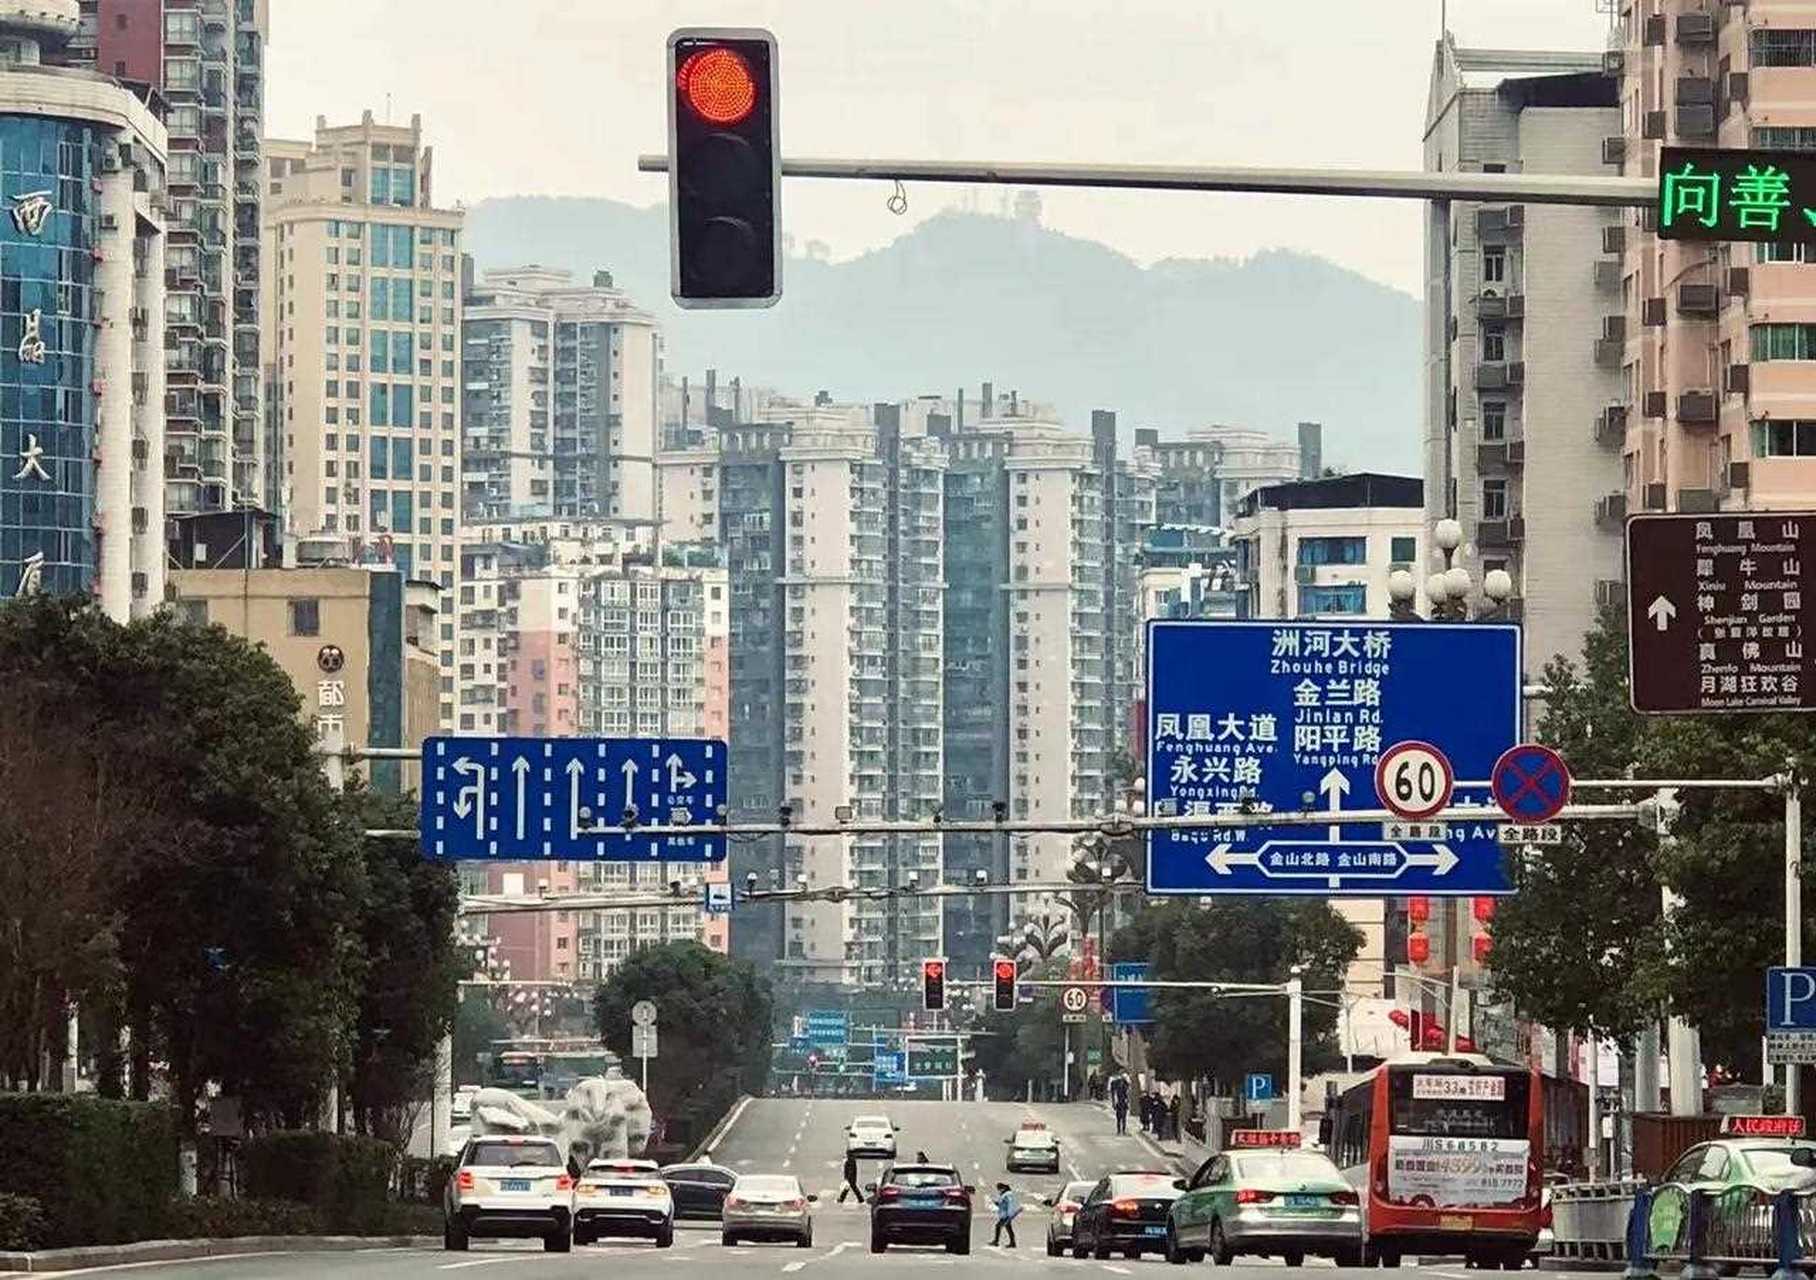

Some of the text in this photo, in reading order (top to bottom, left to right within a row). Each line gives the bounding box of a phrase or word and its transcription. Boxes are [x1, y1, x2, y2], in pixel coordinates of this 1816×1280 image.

[1696, 520, 1799, 539] 凤凰山
[1744, 579, 1798, 591] Mountain
[1759, 613, 1796, 623] Garden
[1271, 630, 1392, 658] 洲河大桥
[1271, 660, 1390, 676] Zhouhe Bridge
[1750, 663, 1801, 673] Mountain
[1293, 680, 1381, 706] 金兰路
[1701, 675, 1798, 694] 月湖狂欢谷
[1294, 709, 1384, 723] Jinlan Rd.
[1155, 714, 1278, 741] 凤凰大道
[1293, 726, 1381, 753] 阳平路
[1156, 742, 1278, 757] Fenghuang Ave.
[1294, 754, 1358, 768] Yangping
[1170, 757, 1262, 783] 永兴路
[1395, 761, 1435, 801] 60
[1503, 827, 1558, 841] 全路段
[1270, 852, 1398, 866] 金山北路 金山南路
[1067, 991, 1083, 1007] 60
[1780, 972, 1816, 1025] P
[1252, 1076, 1266, 1099] P
